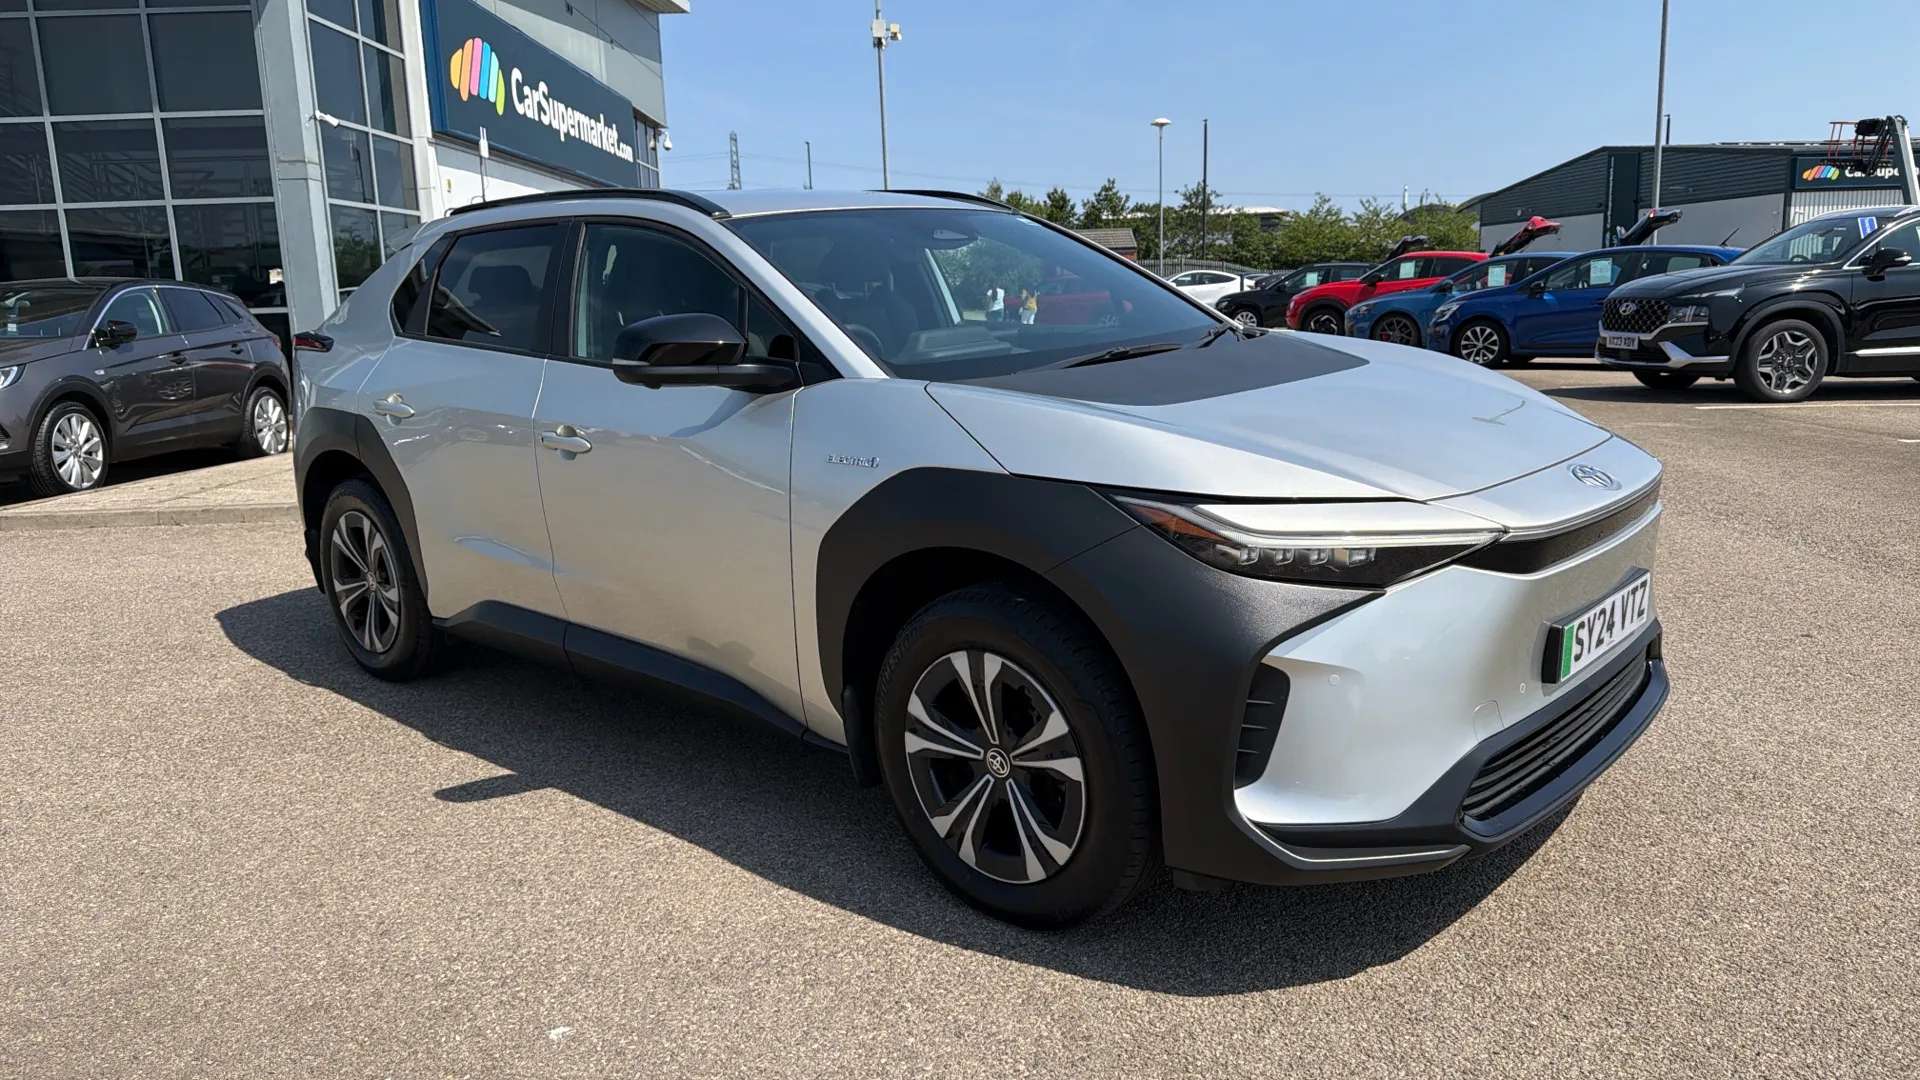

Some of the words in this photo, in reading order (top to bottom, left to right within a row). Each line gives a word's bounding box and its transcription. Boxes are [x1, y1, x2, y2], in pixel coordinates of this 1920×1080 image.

[511, 67, 634, 163] CarSupermarket.com
[1573, 600, 1616, 662] SY24
[1621, 579, 1648, 630] VTZ
